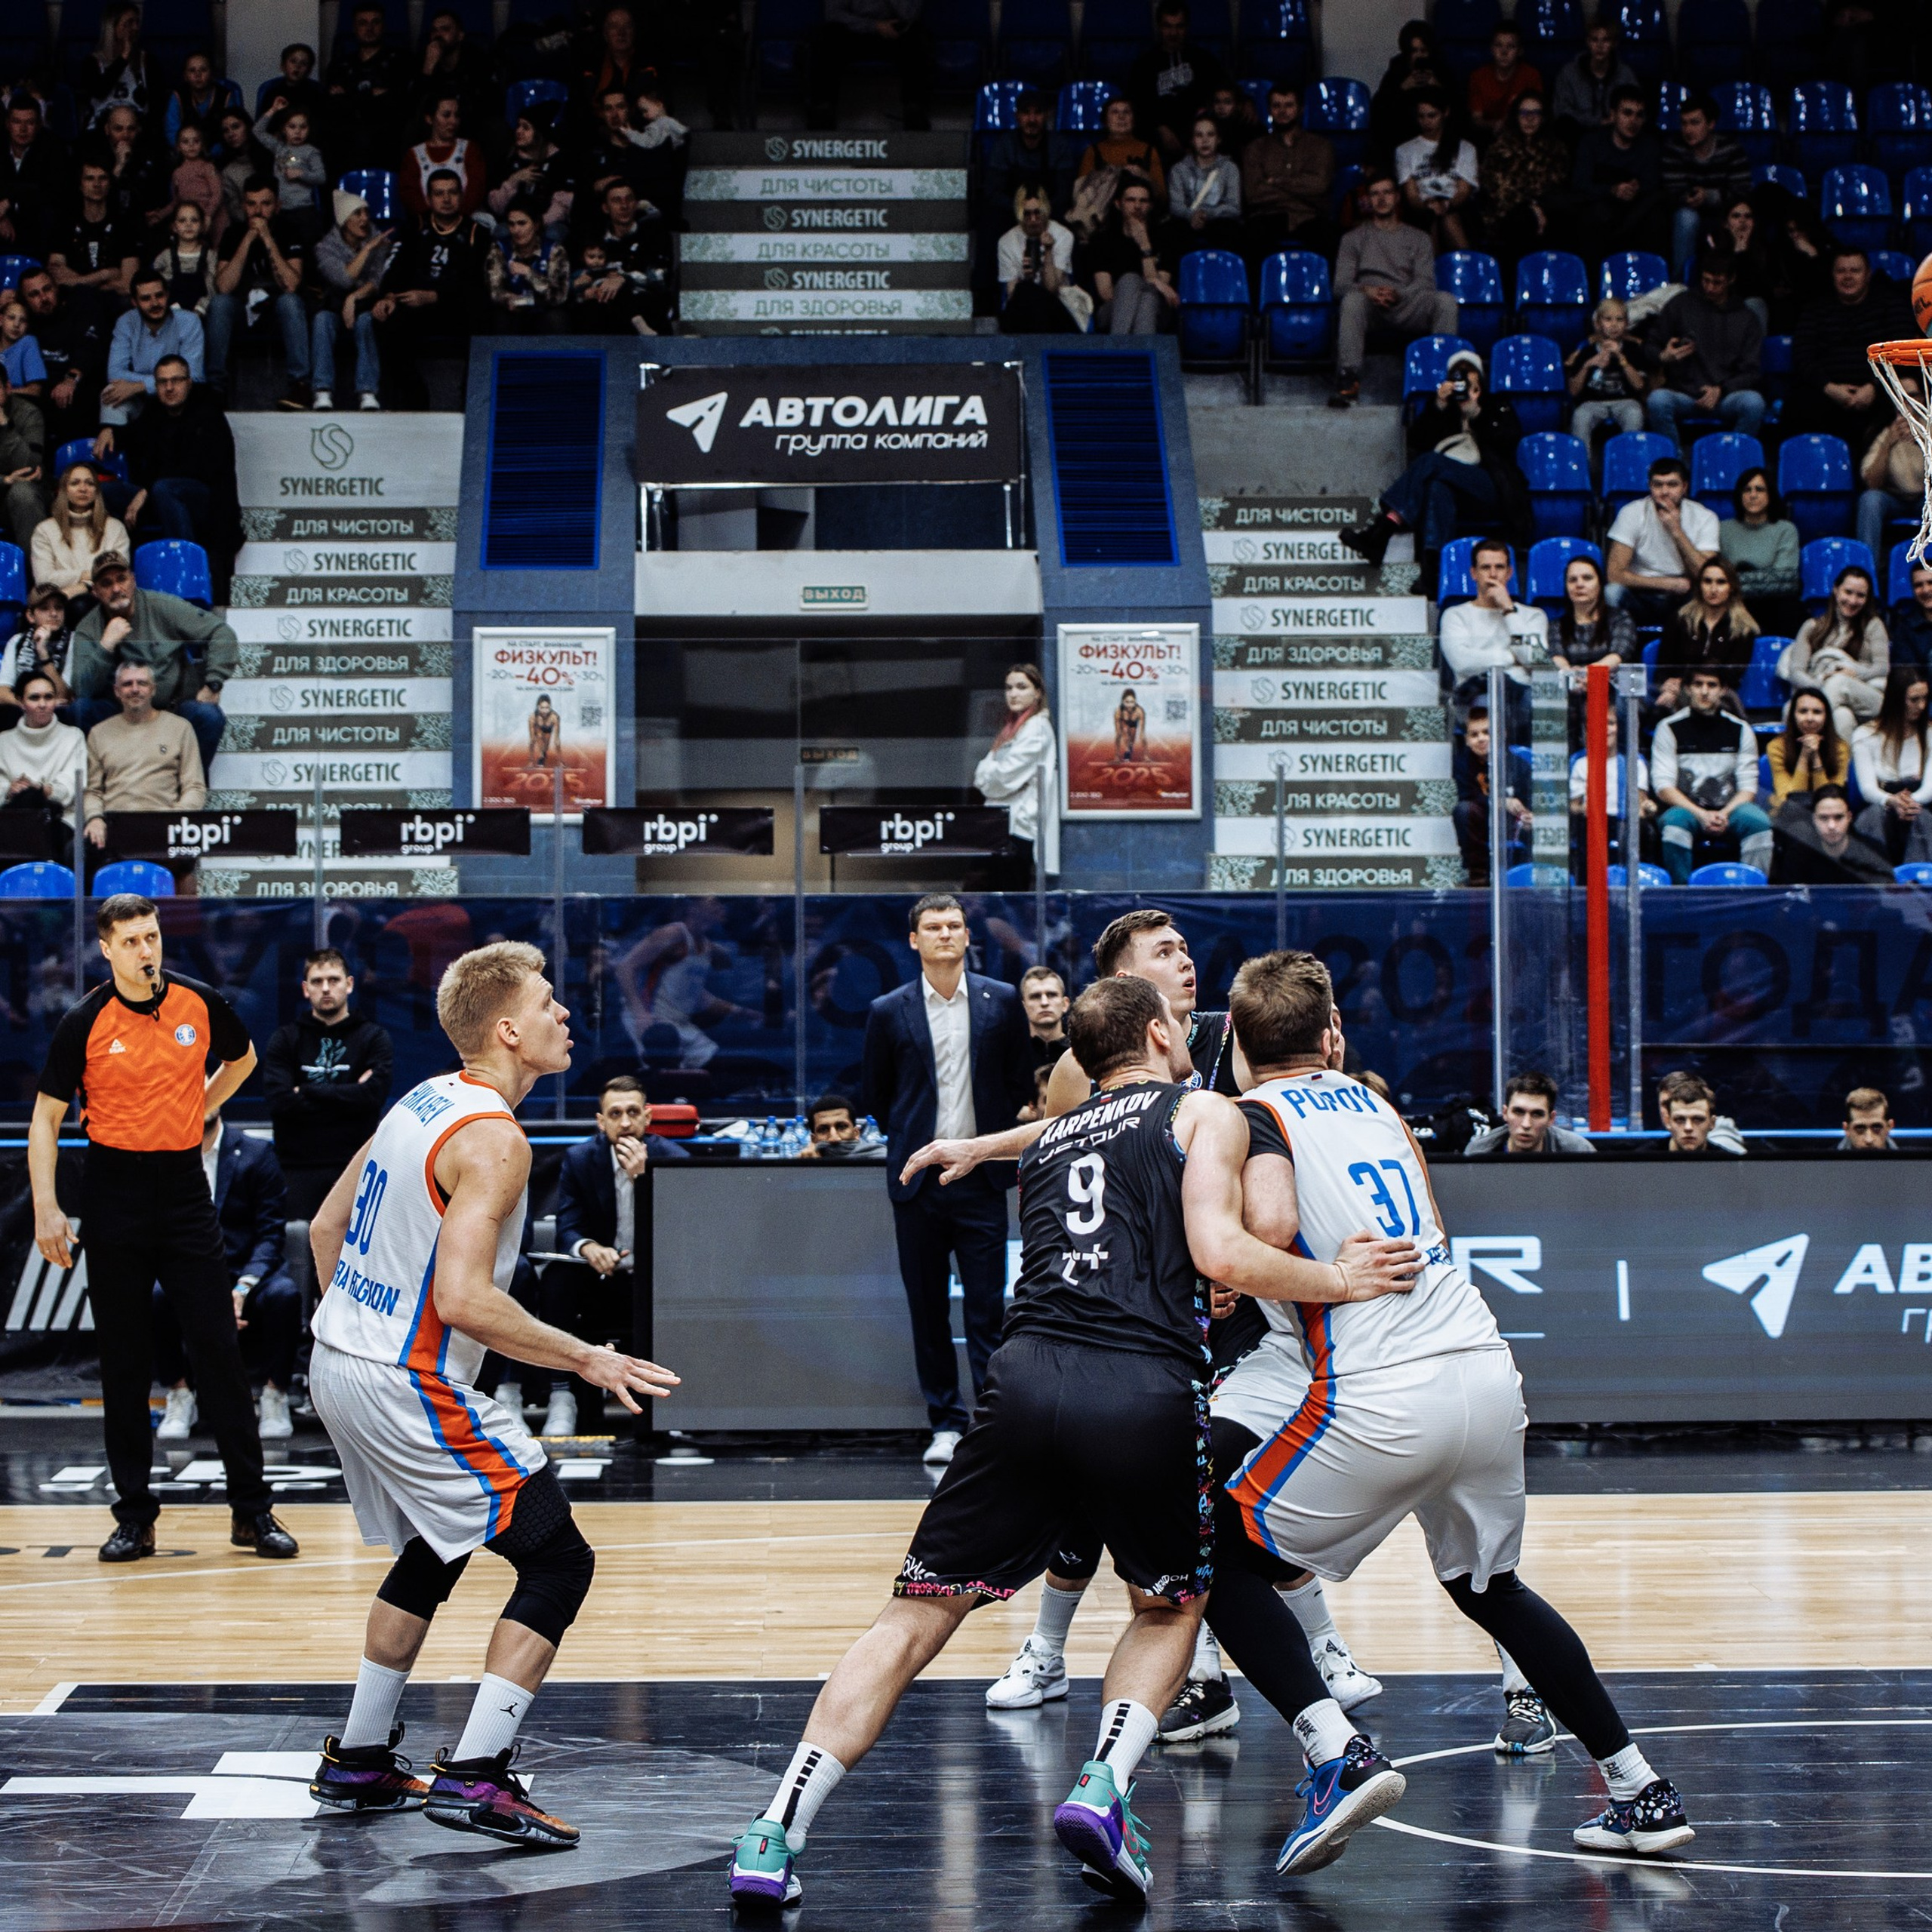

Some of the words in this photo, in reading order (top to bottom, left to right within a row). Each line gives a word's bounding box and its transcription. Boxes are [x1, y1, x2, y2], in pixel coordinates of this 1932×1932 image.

[792, 139, 888, 159] SYNERGETIC
[760, 177, 799, 195] ДЛЯ
[804, 177, 893, 194] ЧИСТОТЫ
[790, 208, 888, 227] SYNERGETIC
[431, 245, 449, 264] 24
[757, 242, 796, 259] ДЛЯ
[800, 243, 889, 258] КРАСОТЫ
[792, 270, 891, 289] SYNERGETIC
[755, 300, 794, 316] ДЛЯ
[799, 300, 902, 316] ЗДОРОВЬЯ
[739, 395, 988, 427] АВТОЛИГА
[775, 433, 866, 456] группа
[874, 430, 988, 449] компаний
[280, 477, 384, 496] SYNERGETIC
[1235, 508, 1272, 525] ДЛЯ
[1275, 508, 1358, 524] ЧИСТОТЫ
[291, 519, 328, 536] ДЛЯ
[332, 519, 414, 535] ЧИСТОТЫ
[1263, 543, 1363, 560] SYNERGETI
[314, 552, 417, 571] SYNERGETIC
[1244, 576, 1280, 593] ДЛЯ
[1284, 576, 1365, 591] КРАСОТЫ
[285, 587, 322, 604] ДЛЯ
[328, 587, 408, 603] КРАСОТЫ
[805, 589, 863, 600] ВЫХОД
[1272, 608, 1375, 627] SYNERGETIC
[308, 619, 412, 637] SYNERGETIC
[495, 649, 597, 666] ФИЗКУЛЬТ!
[1079, 645, 1181, 659] ФИЗКУЛЬТ!
[1247, 647, 1283, 663] ДЛЯ
[1287, 646, 1383, 663] ЗДОРОВЬЯ
[272, 656, 309, 672] ДЛЯ
[315, 656, 409, 672] ЗДОРОВЬЯ
[301, 688, 407, 708] SYNERGETIC
[1281, 681, 1388, 700] SYNERGETIC
[272, 727, 310, 745] ДЛЯ
[315, 727, 400, 743] ЧИСТОТЫ
[1260, 720, 1298, 737] ДЛЯ
[1303, 719, 1388, 736] ЧИСТОТЫ
[1300, 754, 1407, 774] SYNERGETIC
[504, 773, 586, 792] 205
[1272, 792, 1311, 811] ЛЯ
[1315, 792, 1401, 809] КРАСОТЫ
[168, 816, 232, 851] rbpi
[401, 814, 465, 850] rbpi
[644, 814, 708, 848] rbpi
[880, 812, 945, 848] rbpi
[1303, 828, 1411, 848] SYNERGETIC
[168, 844, 201, 857] group
[401, 844, 434, 854] group
[644, 842, 677, 855] group
[881, 841, 915, 854] group
[1313, 869, 1413, 887] ЗДОРОВЬЯ
[1280, 1084, 1379, 1118] POPOV
[1039, 1091, 1161, 1149] KARPENKOV
[1038, 1117, 1140, 1164] JETOUR
[1066, 1152, 1106, 1235] 9
[1347, 1159, 1420, 1238] 37
[344, 1159, 388, 1256] 30
[348, 1269, 401, 1316] REGION
